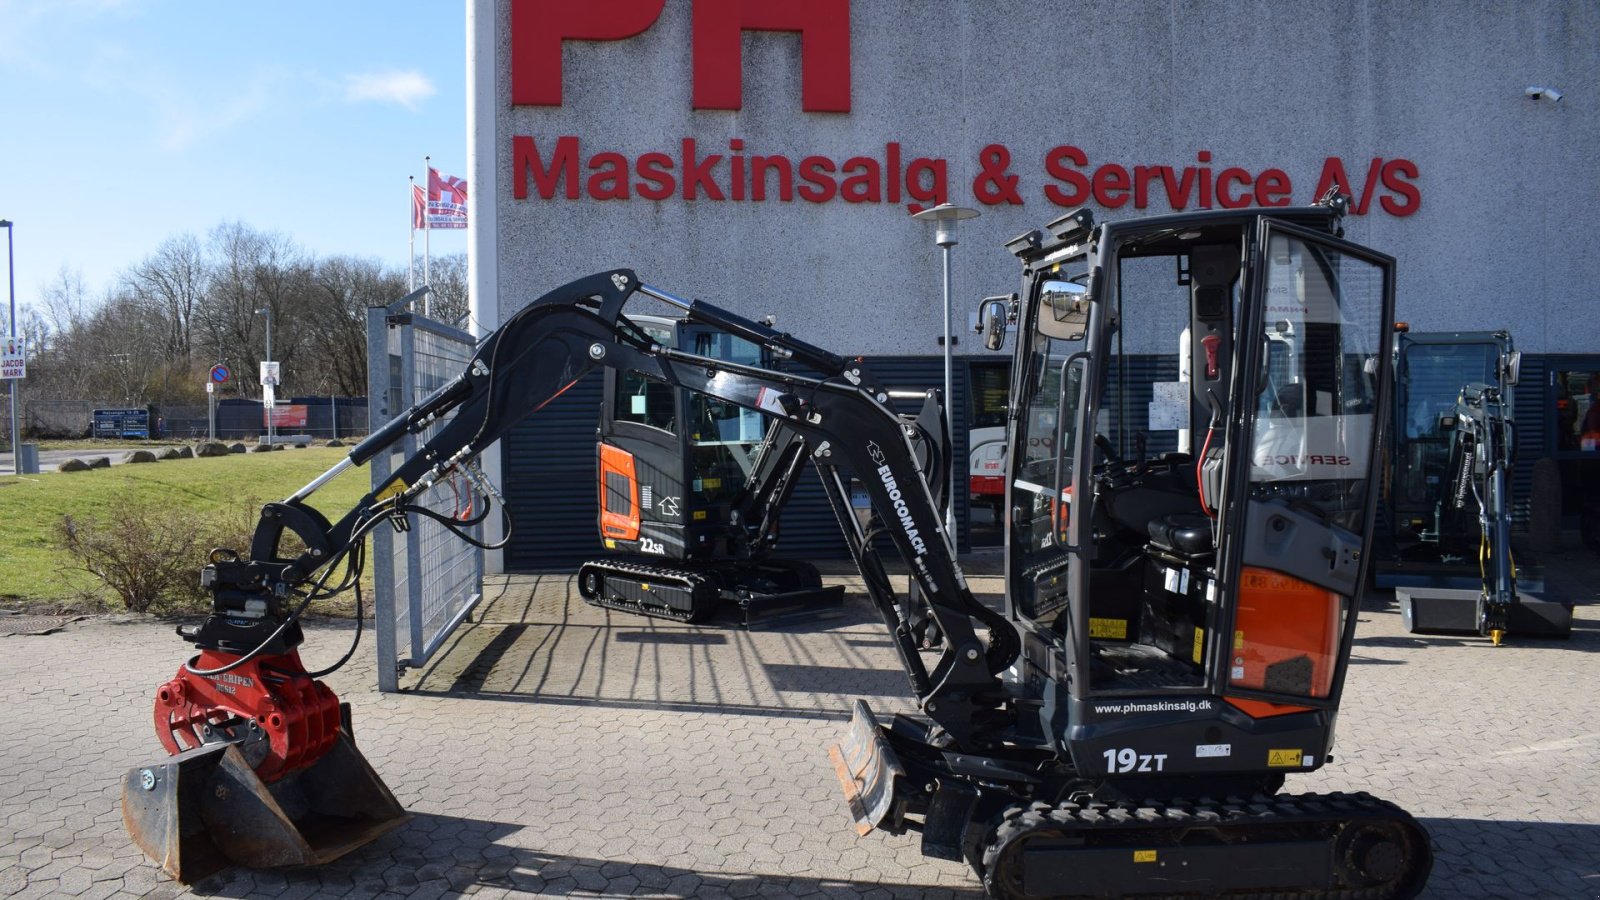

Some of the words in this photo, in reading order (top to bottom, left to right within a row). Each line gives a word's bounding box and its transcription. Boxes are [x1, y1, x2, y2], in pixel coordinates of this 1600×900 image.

[512, 136, 948, 215] Maskinsalg
[973, 144, 1024, 206] &
[1044, 145, 1292, 210] Service
[1313, 157, 1421, 217] A/S
[1, 359, 24, 368] JACOB
[3, 368, 23, 377] MARK
[877, 464, 927, 555] EUROCOMACH
[640, 537, 665, 555] 22SR
[1095, 700, 1212, 714] www.phmaskinsalg.dk
[1103, 747, 1168, 774] 19ZT
